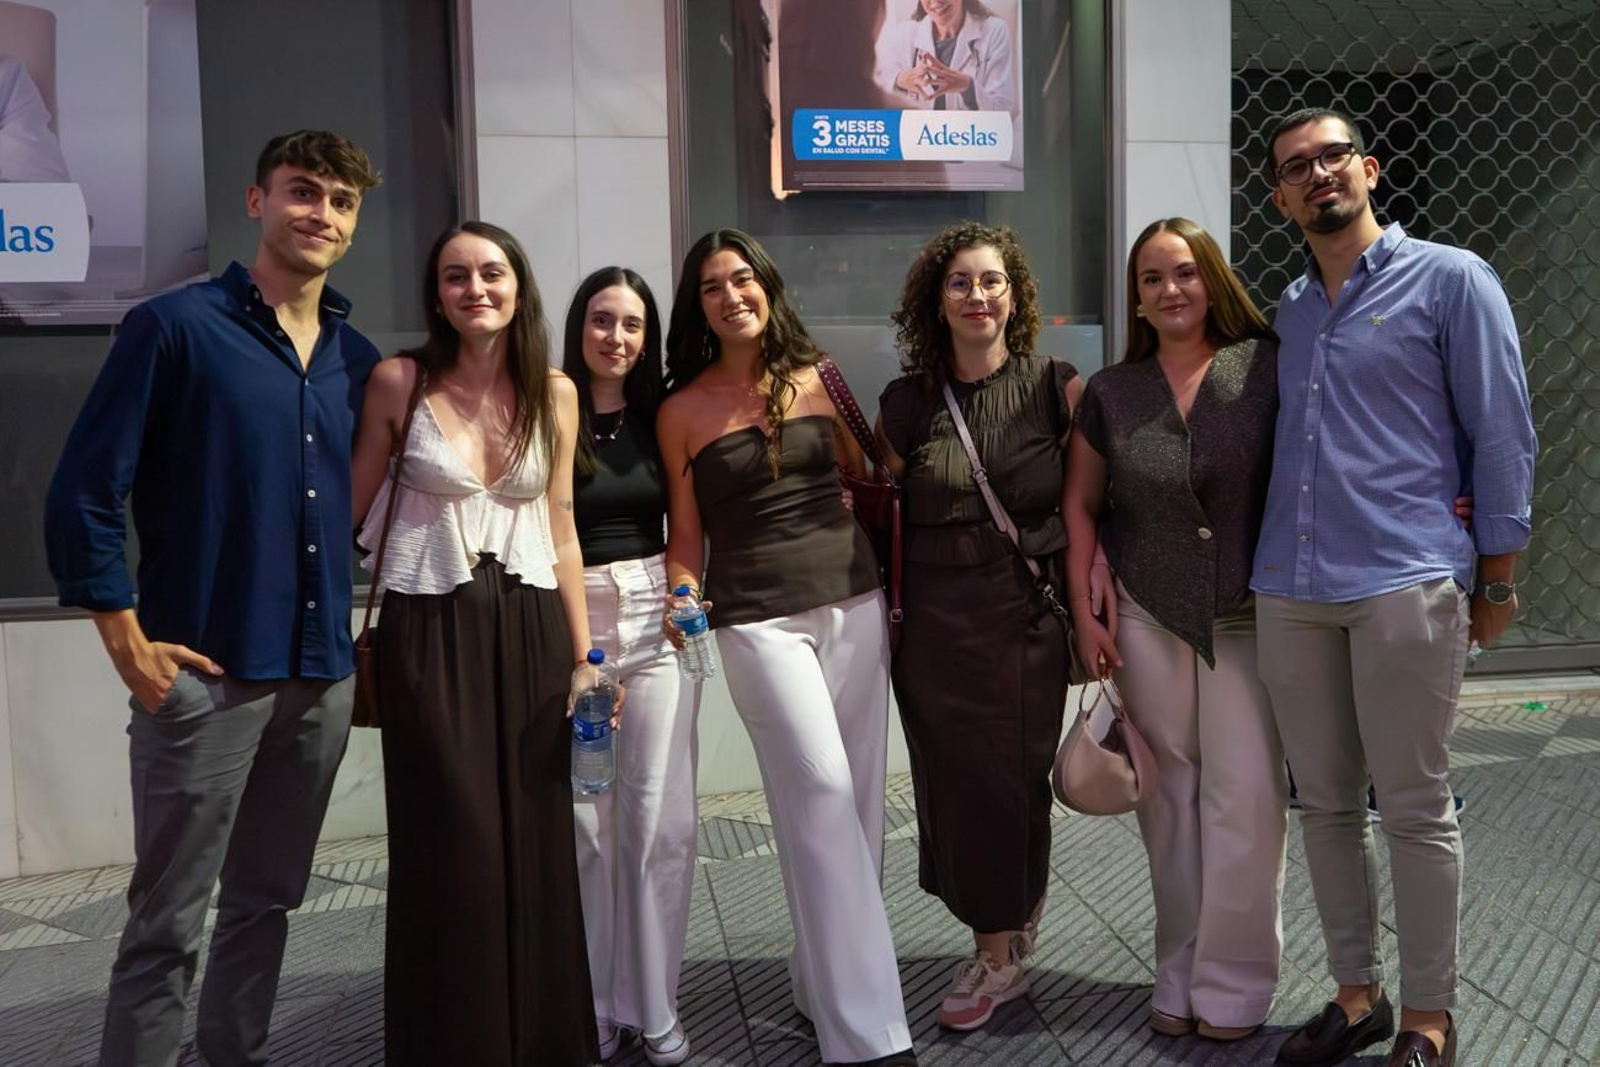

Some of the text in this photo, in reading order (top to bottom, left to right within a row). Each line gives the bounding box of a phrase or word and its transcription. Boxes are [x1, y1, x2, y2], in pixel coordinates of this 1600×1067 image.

[812, 120, 832, 147] 3
[835, 120, 885, 133] MESES
[917, 123, 997, 146] Adeslas
[835, 134, 891, 147] GRATIS
